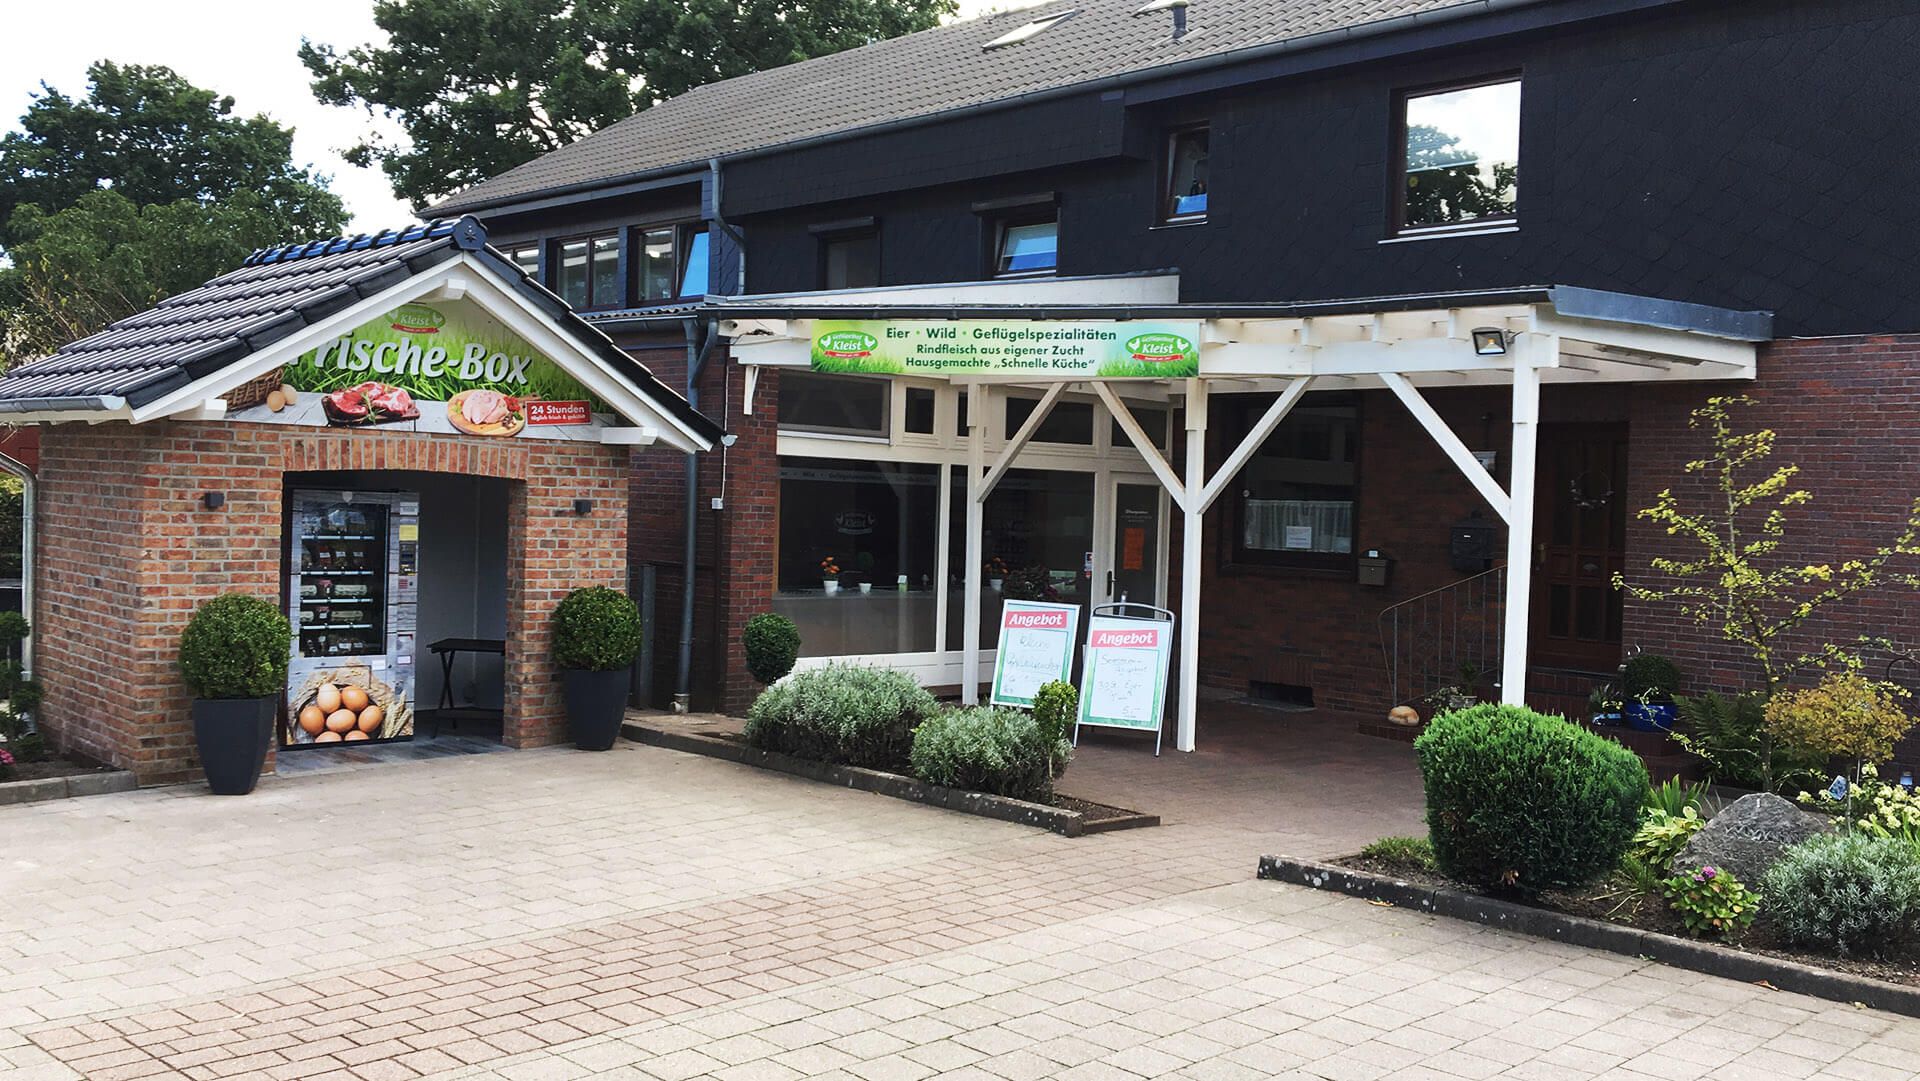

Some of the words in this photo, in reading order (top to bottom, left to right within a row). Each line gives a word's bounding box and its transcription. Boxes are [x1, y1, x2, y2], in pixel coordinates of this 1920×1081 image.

[400, 314, 430, 326] Kleist
[886, 327, 910, 338] Eier
[926, 328, 956, 339] Wild
[973, 327, 1116, 342] Geflügelspezialitäten
[833, 340, 862, 350] Kleist
[916, 343, 977, 354] Rindfleisch
[1004, 345, 1048, 357] eigener
[1052, 345, 1084, 355] Zucht
[1142, 343, 1173, 354] Kleist
[287, 334, 532, 385] rische-Box
[906, 357, 990, 369] Hausgemachte
[994, 358, 1048, 369] „Schnelle
[531, 405, 544, 414] 24
[546, 404, 585, 414] Stunden
[1009, 613, 1063, 627] Angebot
[1097, 632, 1153, 646] Angebot
